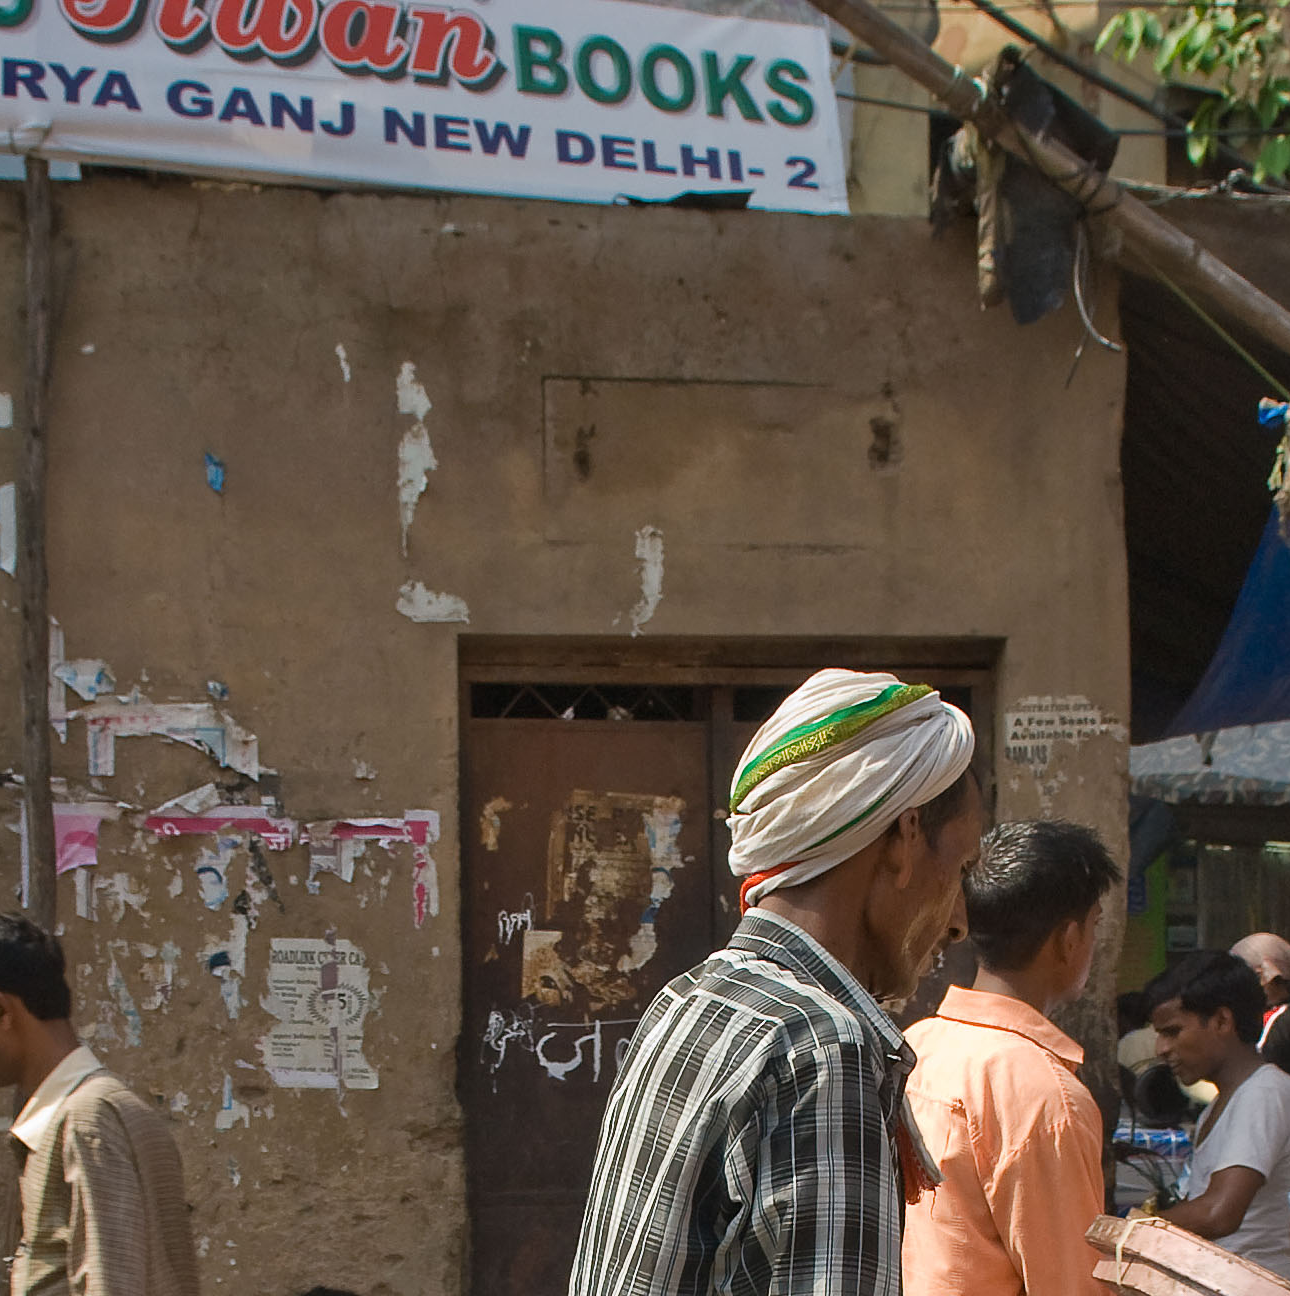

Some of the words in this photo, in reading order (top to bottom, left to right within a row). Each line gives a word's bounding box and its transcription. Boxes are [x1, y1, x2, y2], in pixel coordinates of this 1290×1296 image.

[513, 24, 816, 127] BOOKS
[166, 79, 356, 137] GANJ
[383, 107, 530, 158] NEW
[555, 129, 765, 182] DELHI-
[785, 156, 819, 190] 2
[1011, 730, 1073, 740] Available
[1014, 717, 1023, 726] A
[1028, 717, 1054, 726] Few
[1058, 715, 1096, 725] Seats
